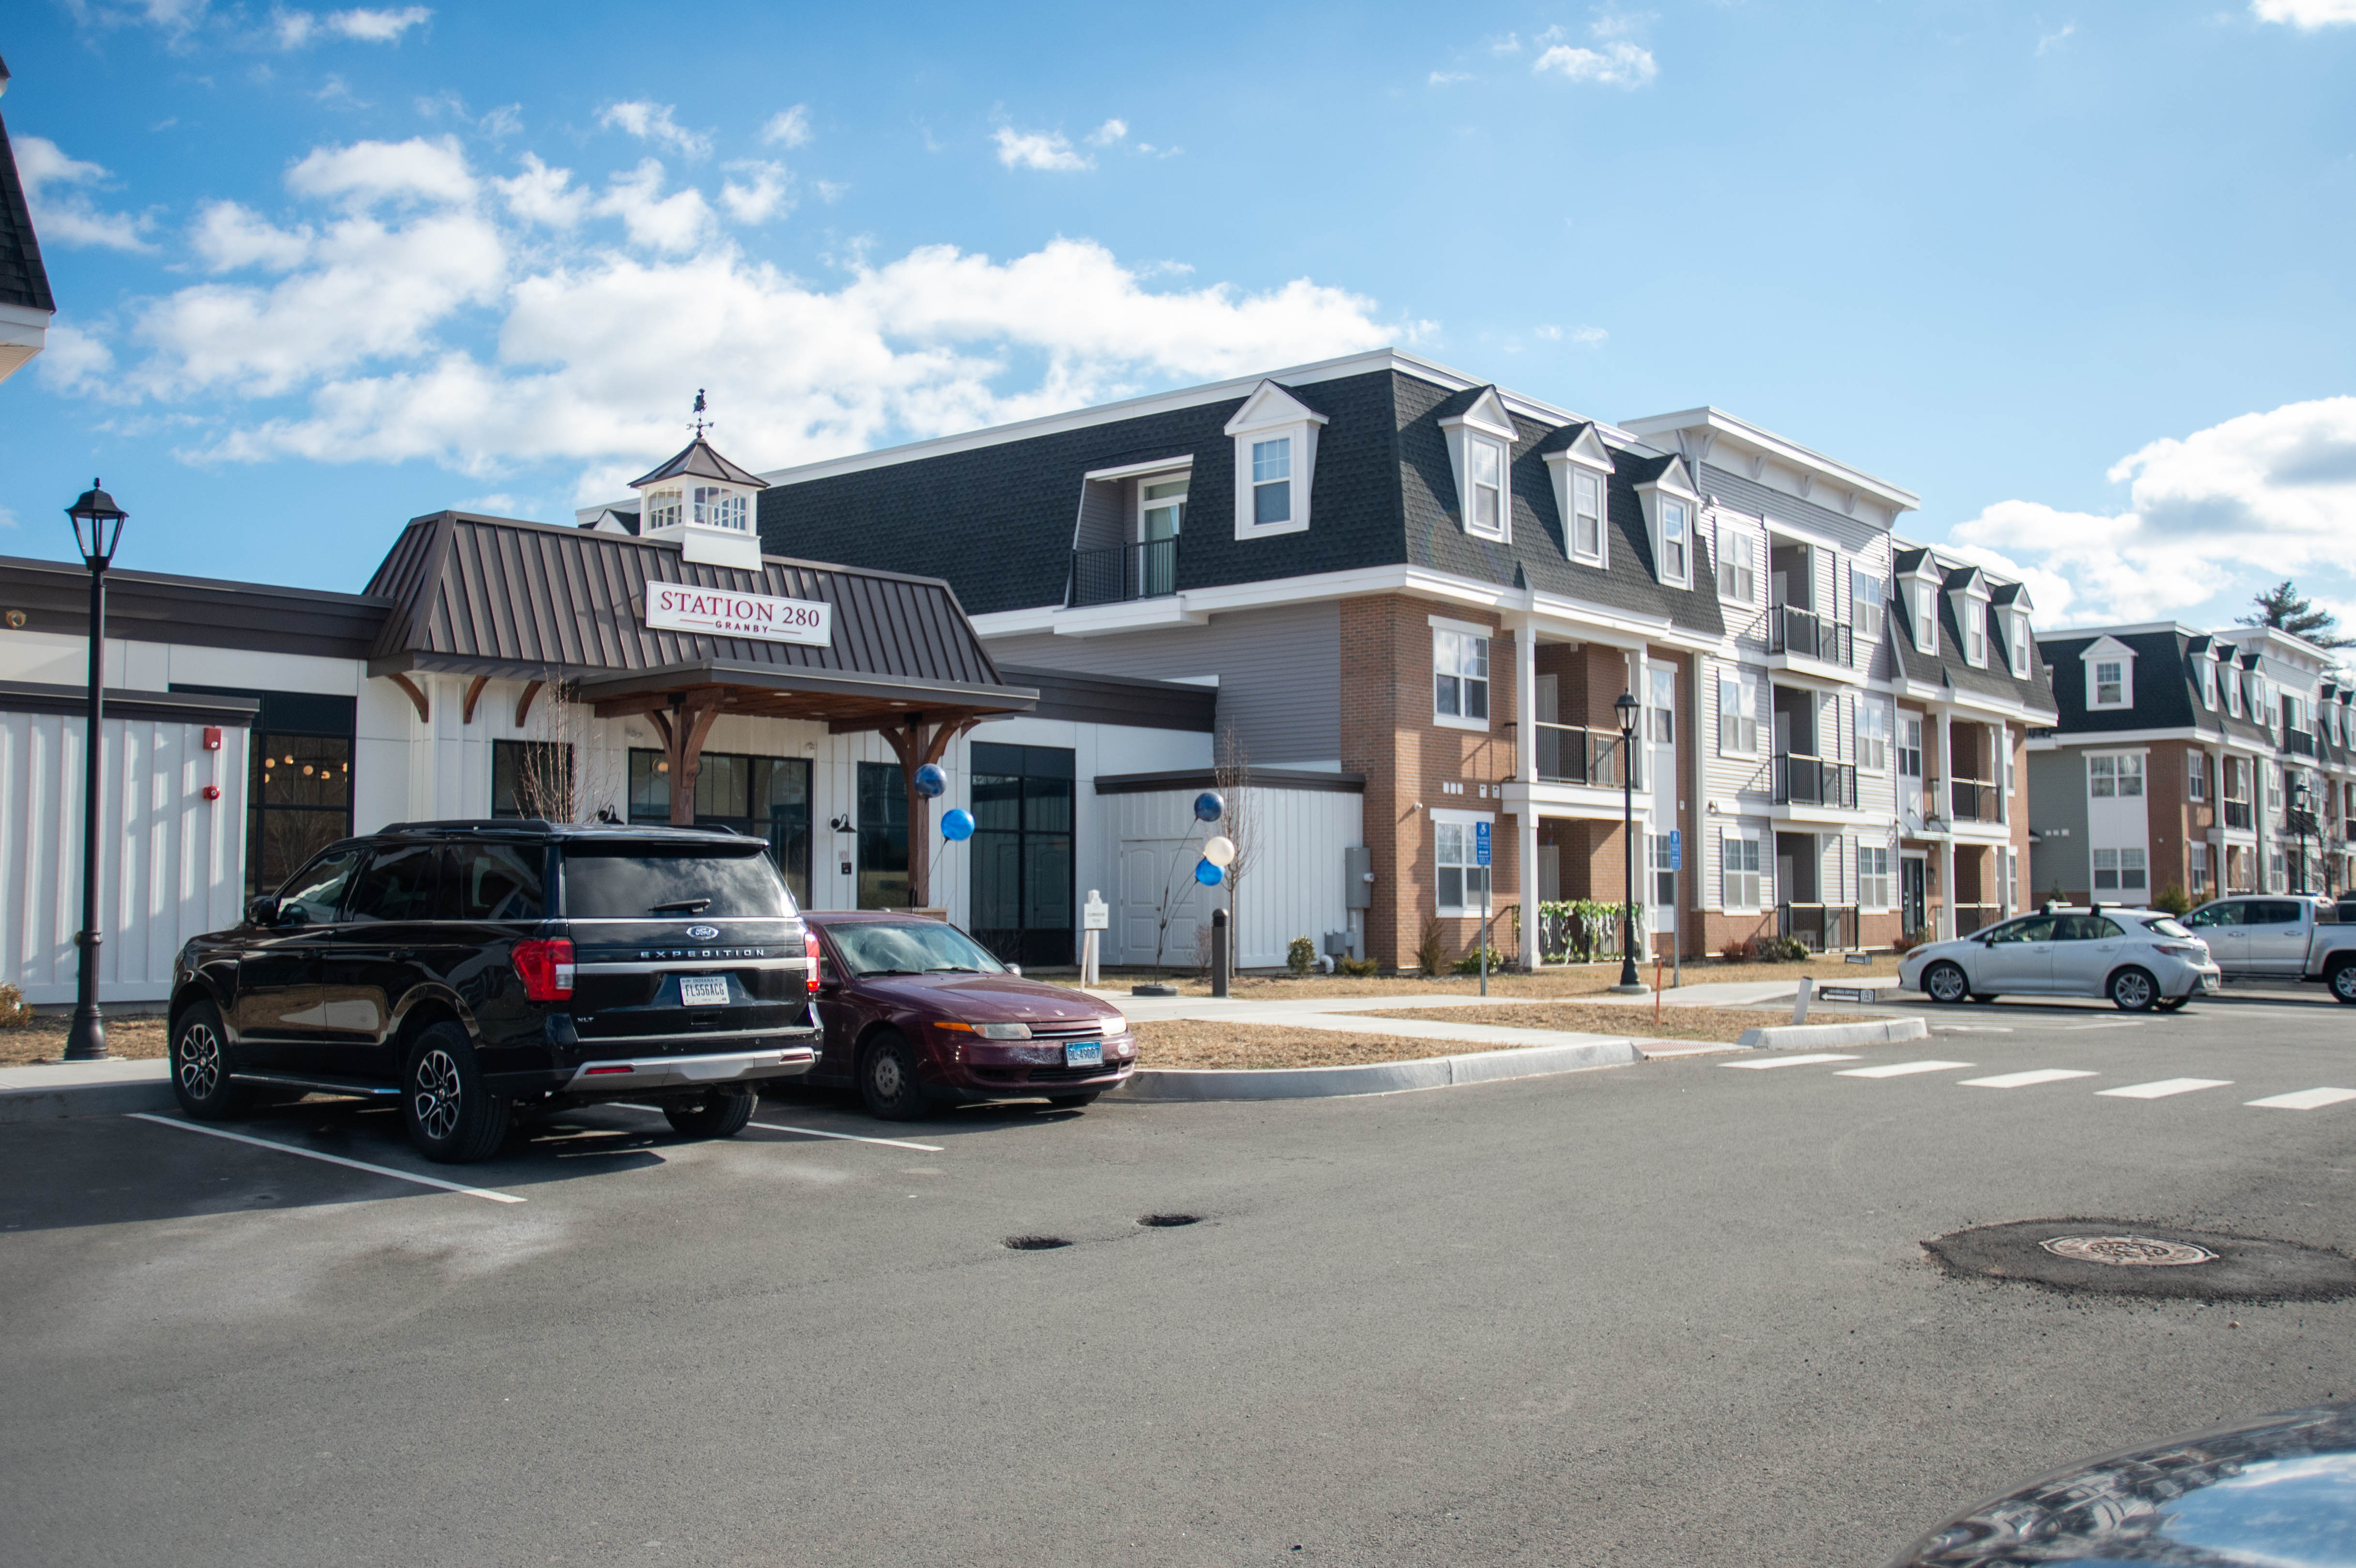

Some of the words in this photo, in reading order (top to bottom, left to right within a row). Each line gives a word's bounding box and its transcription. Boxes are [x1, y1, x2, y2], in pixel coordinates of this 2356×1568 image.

[660, 591, 774, 622] STATION
[782, 606, 820, 627] 280
[715, 620, 769, 634] GRANBY
[640, 949, 765, 959] EXPEDITION
[685, 983, 725, 997] FL556ACG
